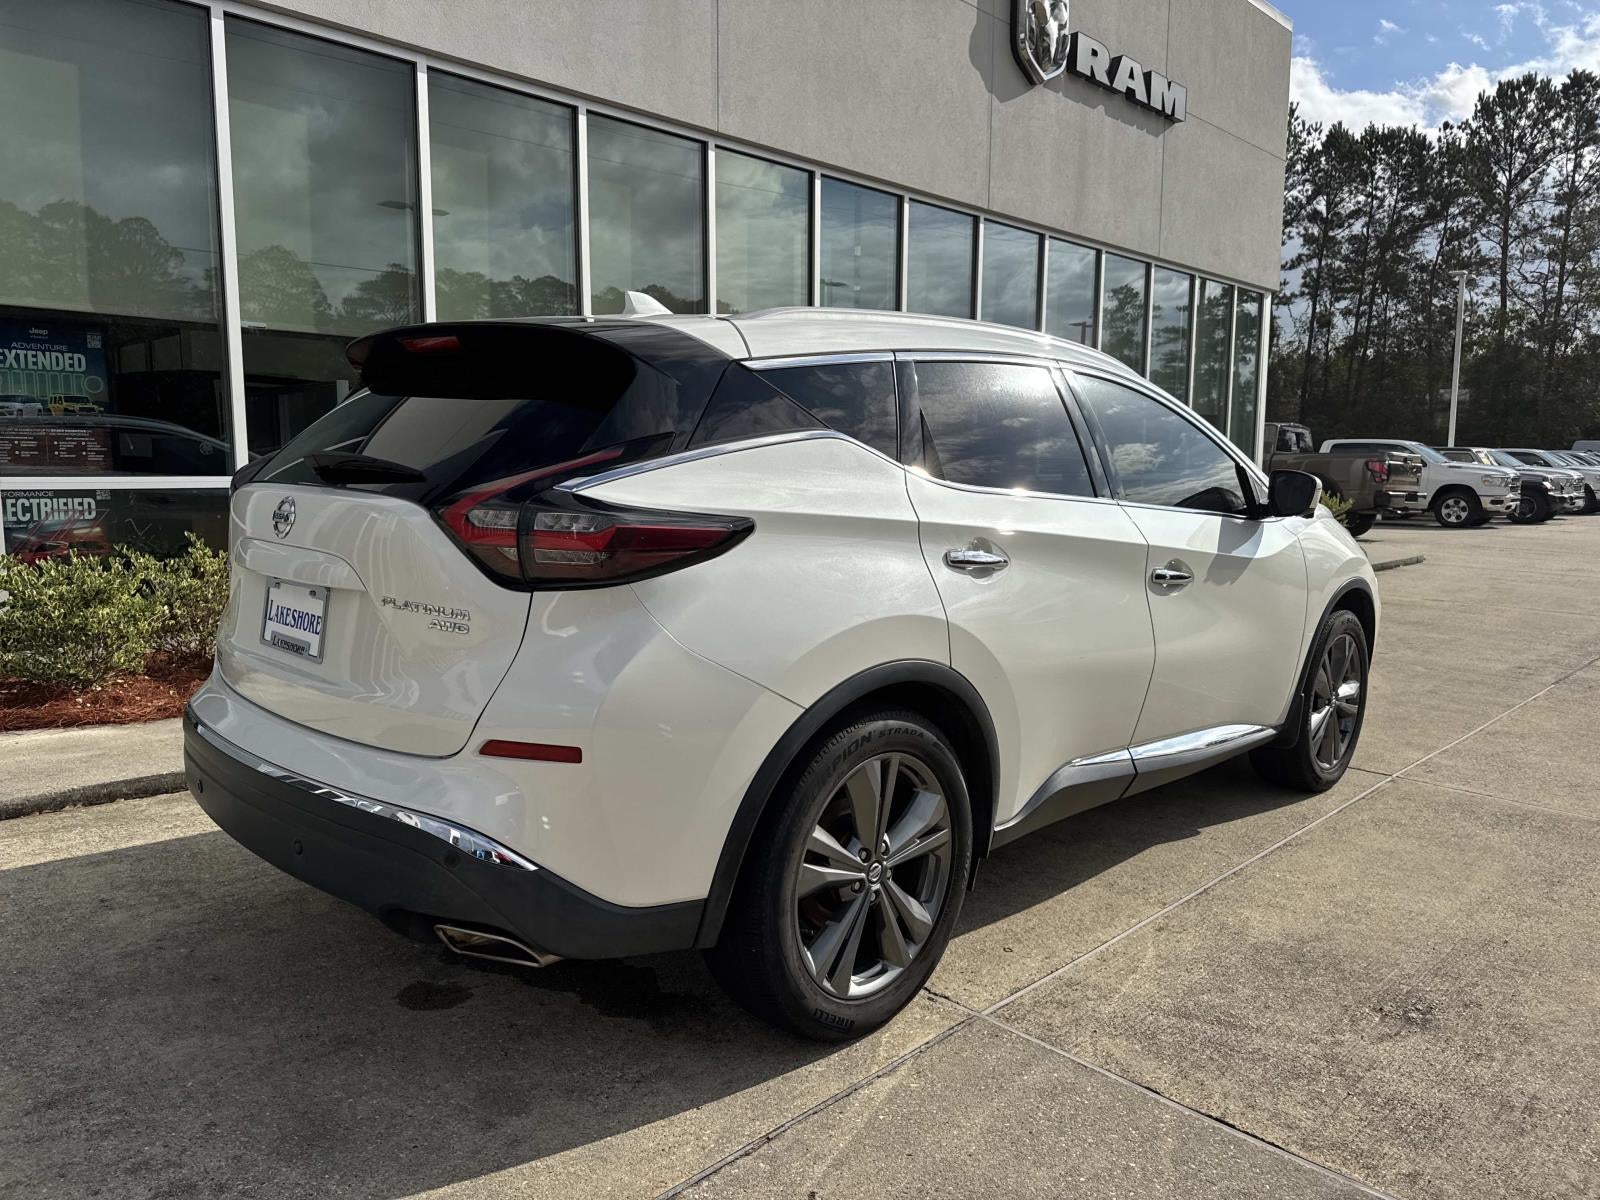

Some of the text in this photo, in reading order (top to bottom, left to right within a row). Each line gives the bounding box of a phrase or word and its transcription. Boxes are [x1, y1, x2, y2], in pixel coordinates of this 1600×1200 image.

[1068, 31, 1187, 122] RAM
[28, 327, 48, 335] Jeep
[11, 341, 69, 352] ADVENTURE
[1, 490, 55, 498] FORMANCE
[3, 497, 97, 522] ECTRIFIED
[381, 596, 471, 621] PLATINUM
[268, 599, 322, 636] LAKESHORE
[428, 619, 470, 634] AWD
[879, 727, 924, 738] STRADA
